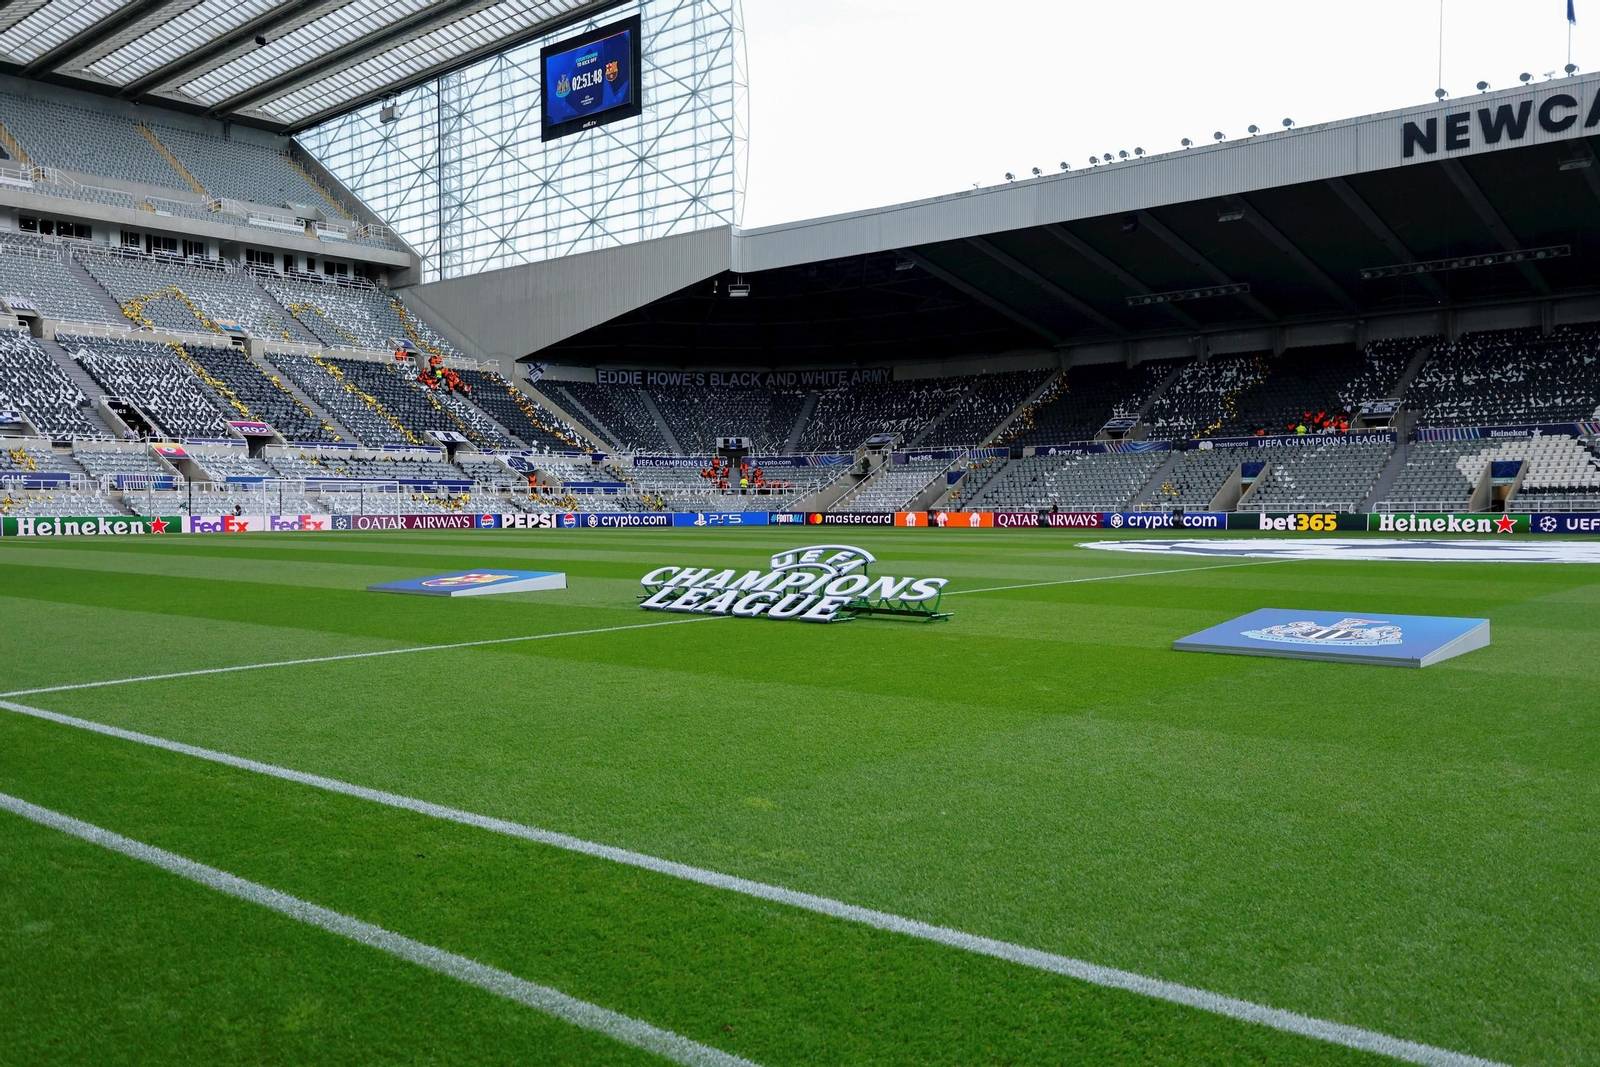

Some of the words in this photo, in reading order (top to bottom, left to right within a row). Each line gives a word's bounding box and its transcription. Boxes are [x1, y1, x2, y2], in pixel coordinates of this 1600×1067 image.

[572, 68, 603, 91] 02:51:48
[597, 370, 642, 385] EDDIE
[647, 371, 704, 386] HOWE'S
[710, 372, 761, 386] BLACK
[765, 372, 797, 386] AND
[801, 370, 847, 385] WHITE
[852, 368, 892, 384] ARMY
[1257, 438, 1283, 447] UEFA
[1285, 436, 1347, 447] CHAMPIONS
[1349, 434, 1391, 445] LEAGUE
[1490, 429, 1528, 438] Heineken
[1215, 440, 1249, 448] mastercard
[636, 459, 654, 467] UEFA
[654, 459, 698, 467] CHAMPIONS
[699, 459, 728, 467] LEAUE
[758, 459, 792, 467] crypto.com
[190, 516, 249, 532] FedEx
[270, 515, 324, 531] FedEx
[358, 516, 407, 529] QATAR
[413, 515, 470, 529] AIRWAYS
[501, 513, 556, 528] PEPSI
[601, 514, 667, 528] crypto.com
[770, 514, 803, 524] #FOOTBALL
[825, 513, 891, 524] mastercard
[998, 513, 1039, 527] QATAR
[1259, 513, 1337, 531] bet365
[1379, 514, 1492, 533] Heineken
[1566, 518, 1600, 531] UEF
[16, 517, 145, 536] Heineken
[771, 548, 869, 578] UEFA
[640, 566, 950, 603] CHAMPIONS
[639, 588, 853, 623] LEAGUE
